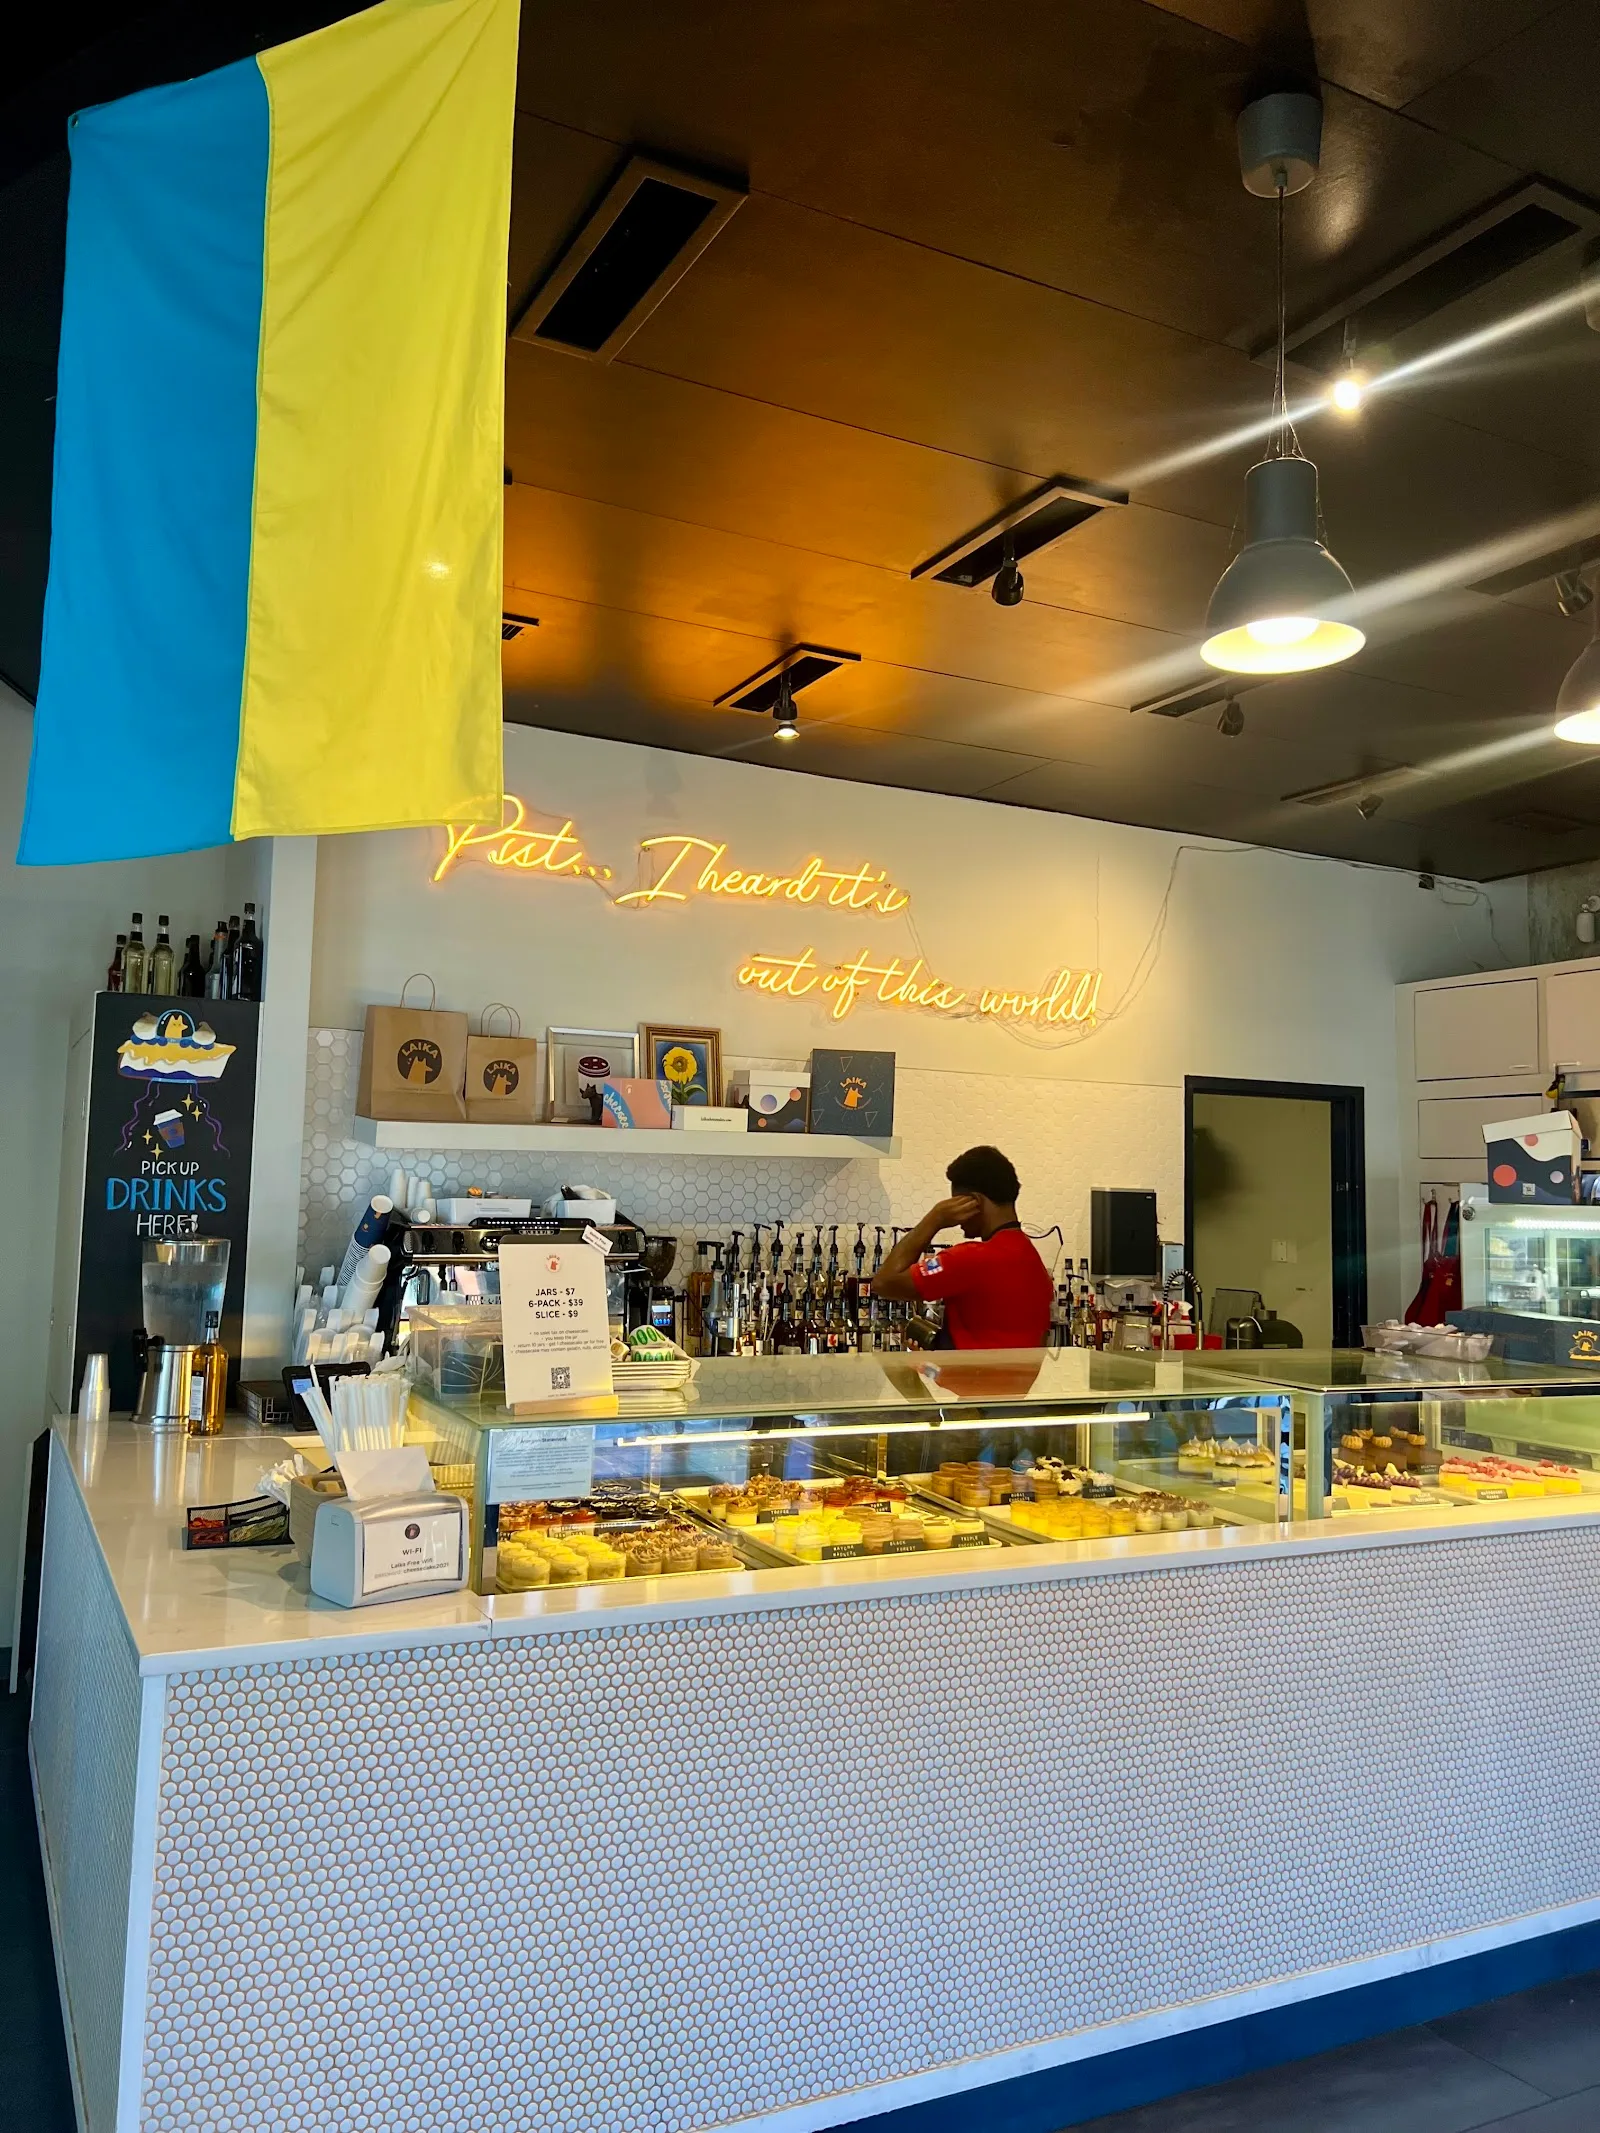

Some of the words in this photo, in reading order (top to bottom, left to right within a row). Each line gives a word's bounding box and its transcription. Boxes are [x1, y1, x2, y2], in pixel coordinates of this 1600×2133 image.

[614, 835, 720, 904] I
[696, 843, 822, 903] heard
[817, 862, 910, 913] it's
[738, 947, 820, 997] out
[820, 949, 872, 1019] of
[873, 958, 966, 1010] this
[979, 968, 1103, 1028] world!
[401, 1041, 439, 1060] LAIKA
[486, 1061, 517, 1075] LAIKA
[839, 1076, 868, 1089] LAIKA
[141, 1160, 177, 1175] PICK
[180, 1161, 200, 1175] UP
[106, 1178, 227, 1212] DRINKS
[136, 1213, 199, 1236] HERE!
[535, 1288, 557, 1296] JARS
[565, 1287, 575, 1296] $7
[528, 1299, 560, 1308] 6-PACK
[568, 1298, 584, 1307] $39
[535, 1310, 560, 1319] SLICE
[568, 1309, 579, 1318] $9
[1572, 1330, 1598, 1341] LAIKA
[402, 1547, 422, 1555] WI-FI
